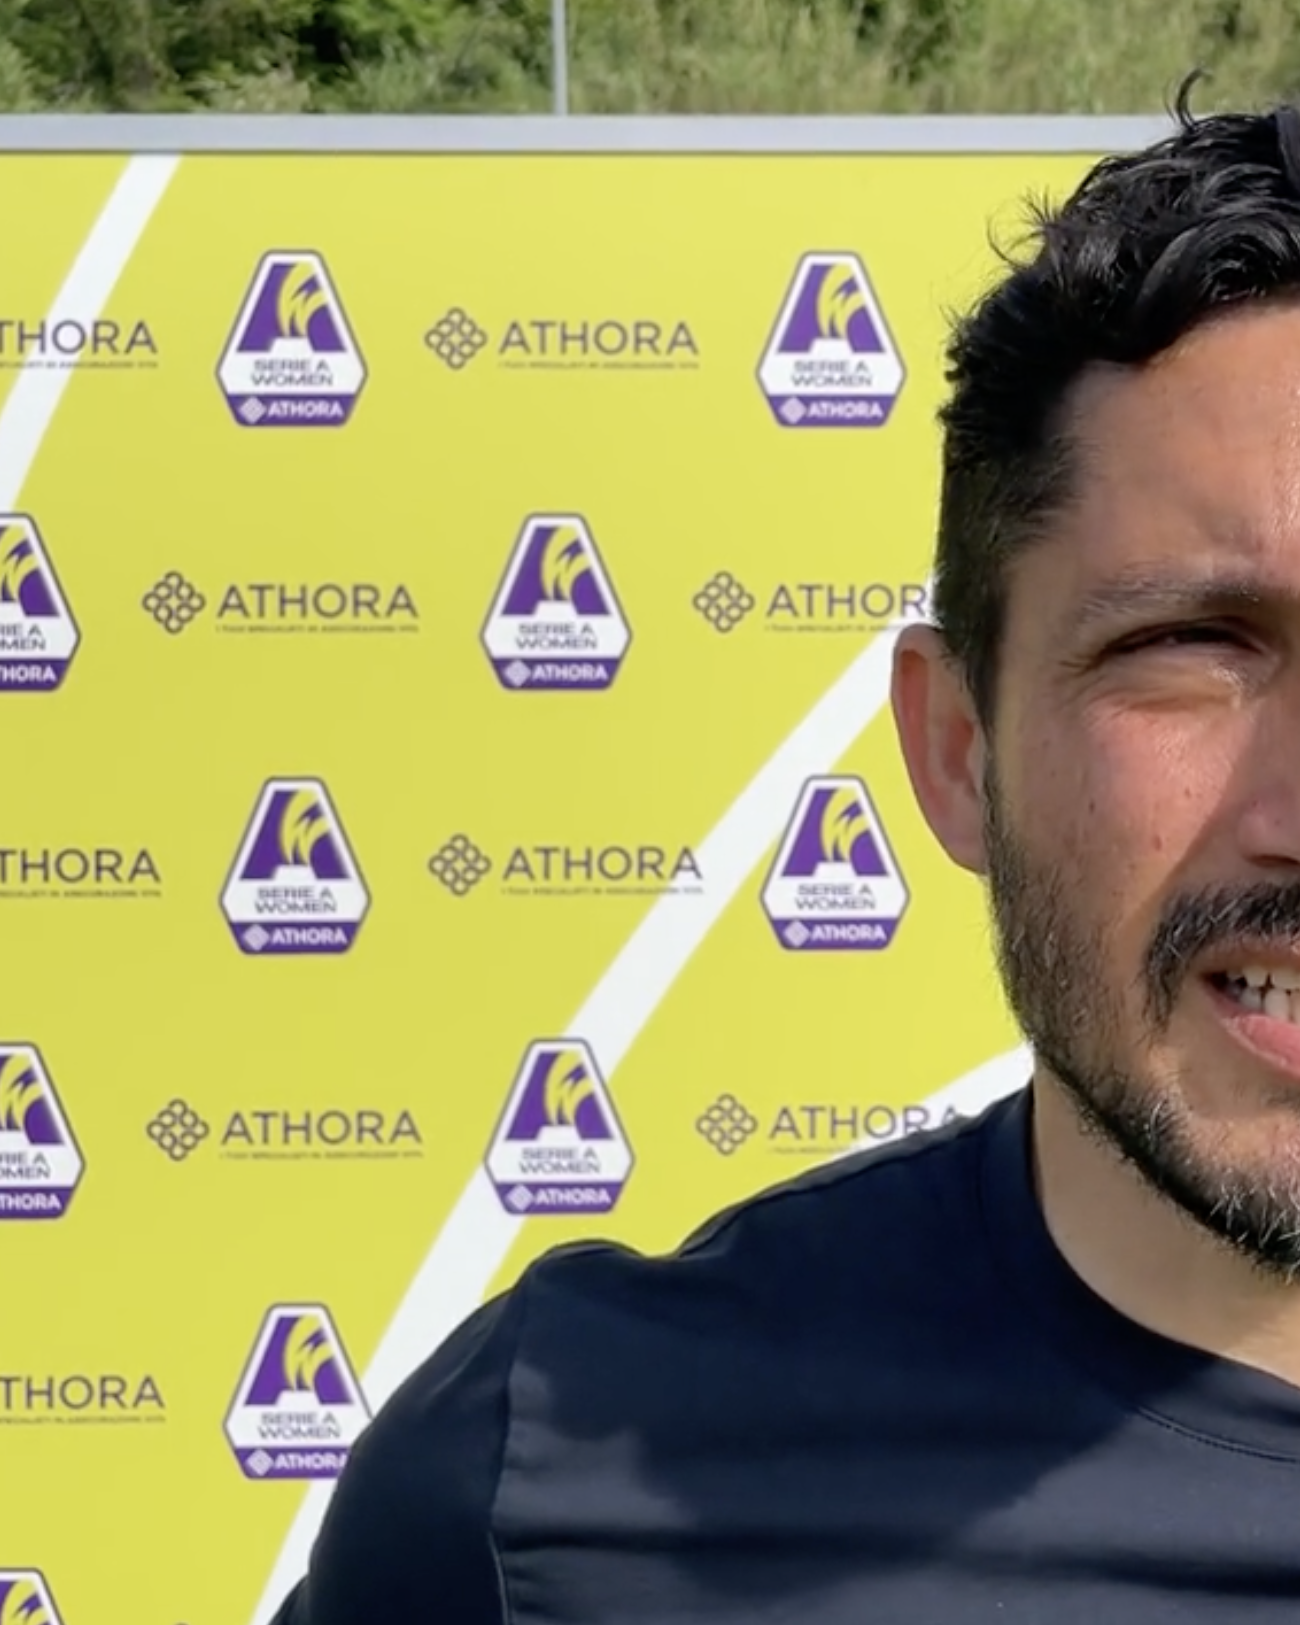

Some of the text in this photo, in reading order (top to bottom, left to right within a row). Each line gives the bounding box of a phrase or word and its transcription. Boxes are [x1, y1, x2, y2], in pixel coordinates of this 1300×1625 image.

[0, 320, 158, 355] THORA
[497, 320, 699, 356] ATHORA
[254, 360, 309, 371] SERIE
[794, 360, 849, 371] SERIE
[251, 373, 333, 386] WOMEN
[791, 373, 872, 386] WOMEN
[267, 401, 343, 417] ATHORA
[807, 402, 882, 418] ATHORA
[217, 584, 419, 619] ATHORA
[766, 583, 927, 619] ATHOR
[518, 623, 573, 634] SERIE
[516, 636, 597, 649] WOMEN
[532, 665, 607, 681] ATHORA
[0, 848, 161, 884] THORA
[502, 846, 702, 881] ATHORA
[257, 887, 312, 898] SERIE
[798, 884, 853, 895] SERIE
[254, 900, 337, 913] WOMEN
[795, 897, 876, 910] WOMEN
[271, 929, 346, 945] ATHORA
[811, 925, 886, 941] ATHORA
[220, 1110, 422, 1146] ATHORA
[522, 1147, 577, 1158] SERIE
[519, 1160, 600, 1173] WOMEN
[0, 1193, 61, 1210] THORA
[535, 1189, 611, 1205] ATHORA
[0, 1375, 165, 1410] THORA
[261, 1412, 316, 1423] SERIE
[257, 1425, 340, 1438] WOMEN
